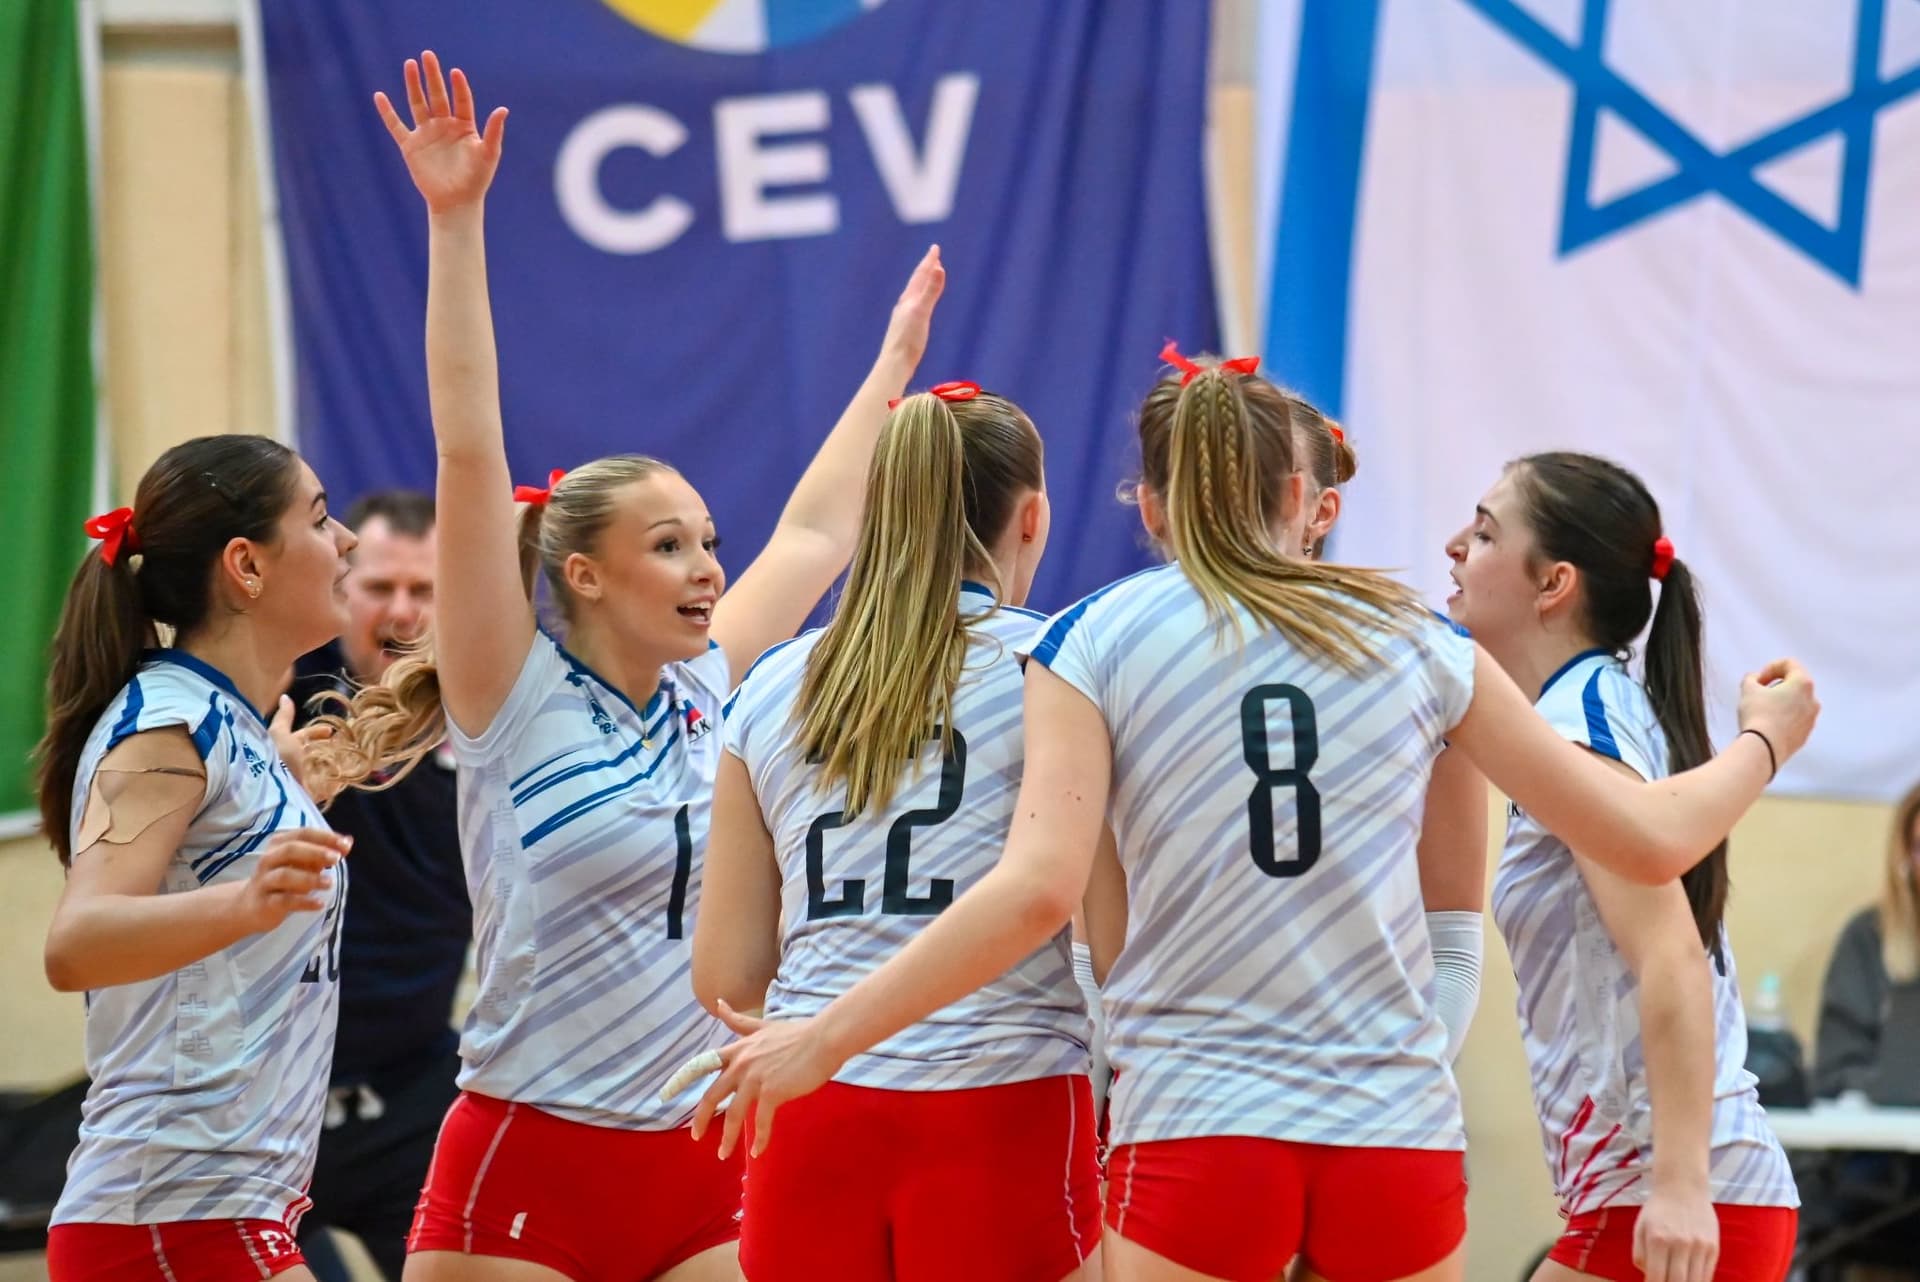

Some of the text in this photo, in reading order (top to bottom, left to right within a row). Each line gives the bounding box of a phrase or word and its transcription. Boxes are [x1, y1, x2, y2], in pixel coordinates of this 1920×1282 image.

[554, 71, 979, 254] CEV
[667, 803, 693, 940] 1
[804, 723, 968, 922] 22
[1240, 683, 1322, 878] 8
